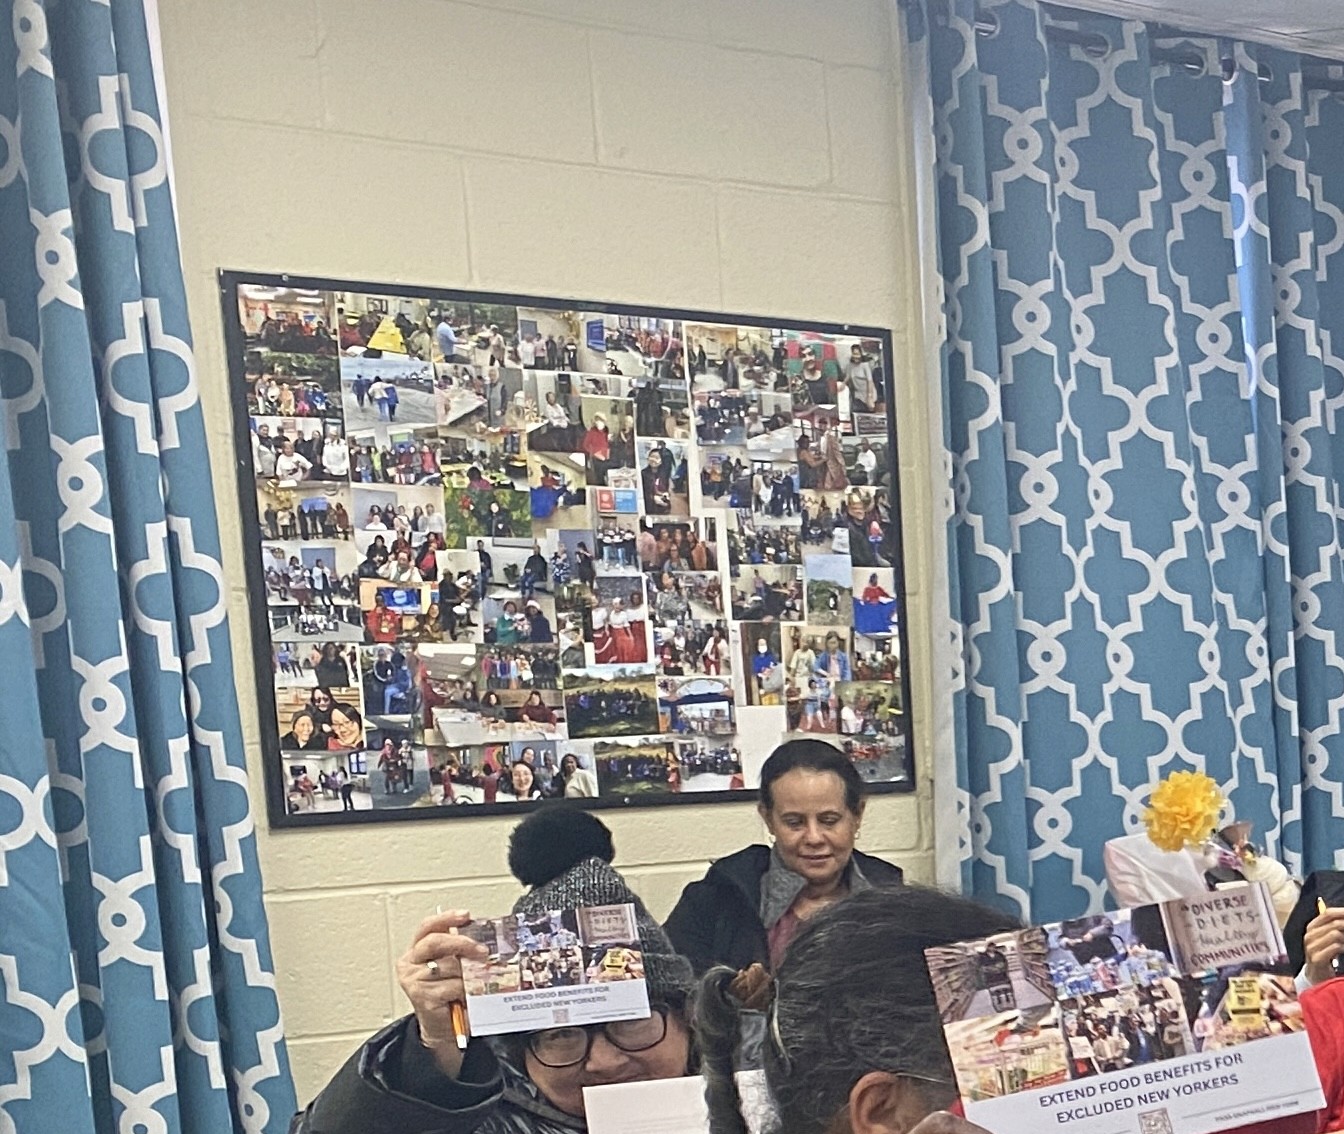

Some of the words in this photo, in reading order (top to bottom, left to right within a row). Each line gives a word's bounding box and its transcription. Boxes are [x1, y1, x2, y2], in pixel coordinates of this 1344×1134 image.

[1191, 895, 1248, 916] DIVERSE
[1039, 1085, 1097, 1108] EXTEND
[1100, 1075, 1141, 1095] FOOD
[1144, 1060, 1213, 1085] BENEFITS
[1215, 1053, 1244, 1070] FOR
[1056, 1097, 1134, 1124] EXCLUDED
[1138, 1088, 1170, 1106] NEW
[1172, 1073, 1239, 1097] YORKERS
